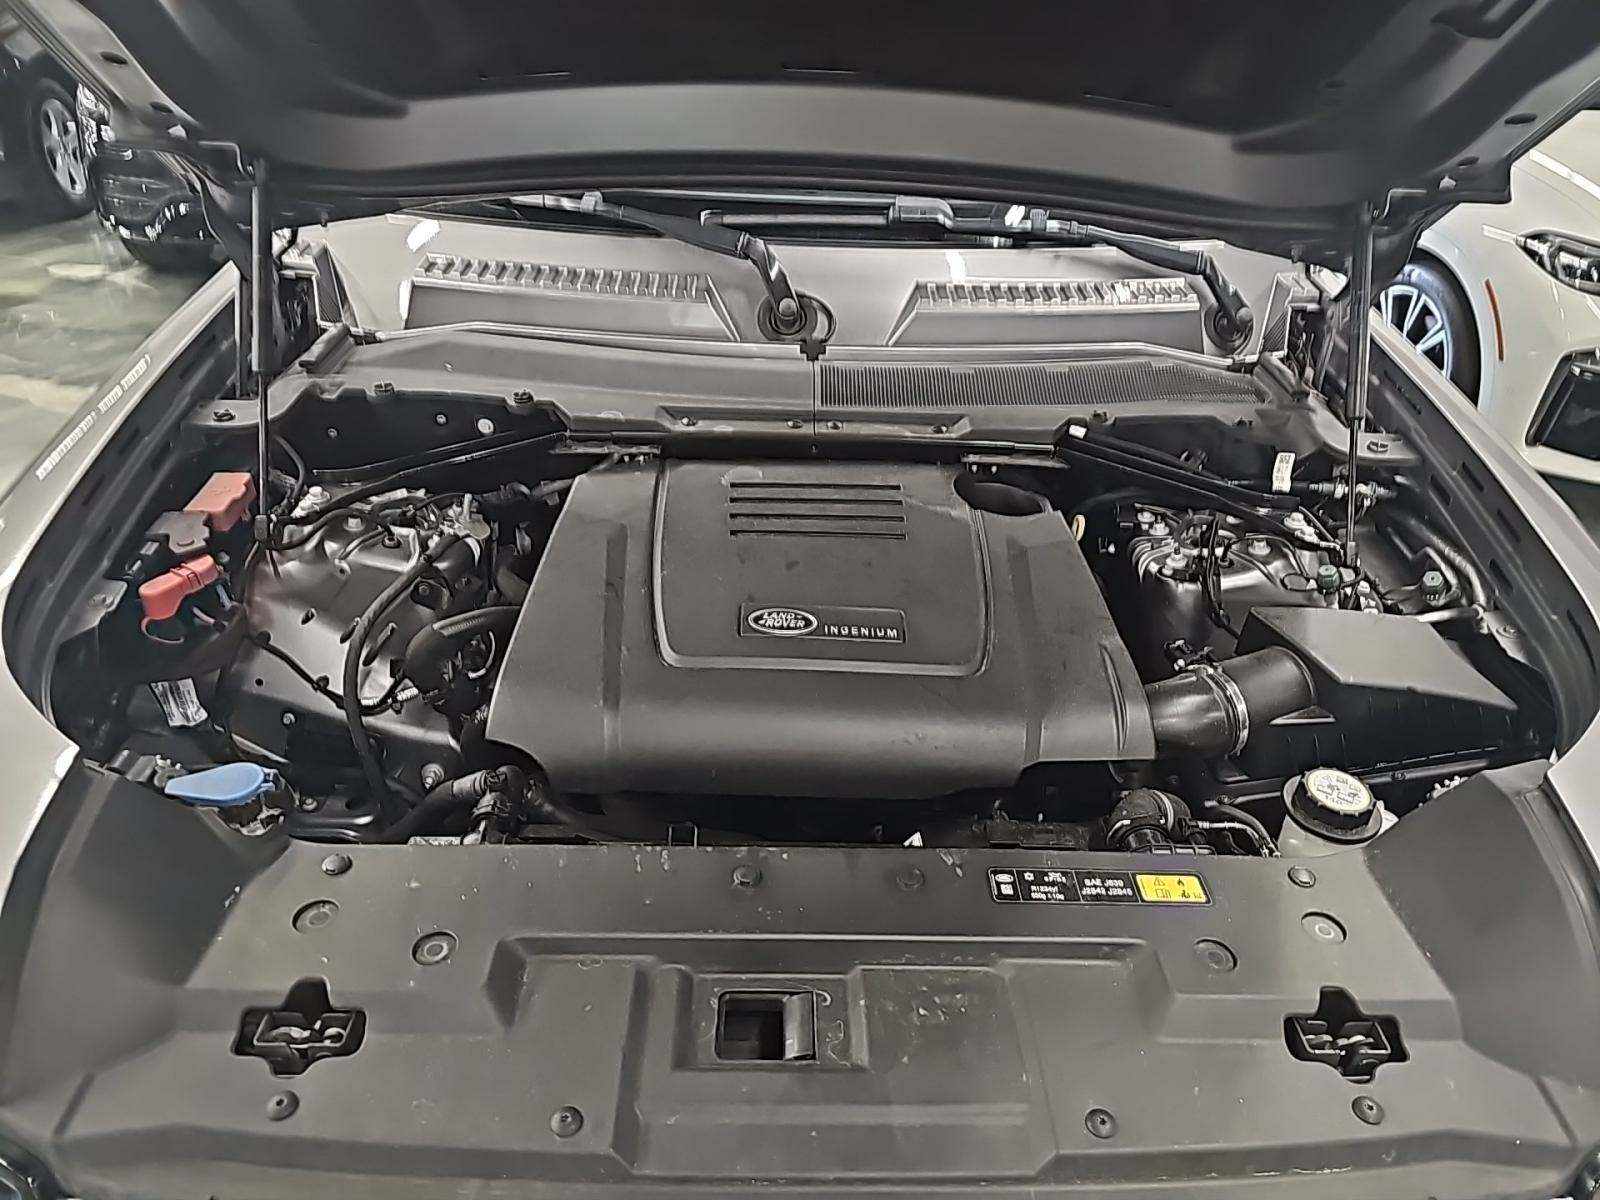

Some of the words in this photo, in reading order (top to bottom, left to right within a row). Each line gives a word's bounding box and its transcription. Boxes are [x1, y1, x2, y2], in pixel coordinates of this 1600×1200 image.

[763, 612, 796, 620] LAND
[764, 619, 806, 628] ROVER
[824, 624, 898, 639] INGENIUM
[1083, 878, 1103, 887] SAE
